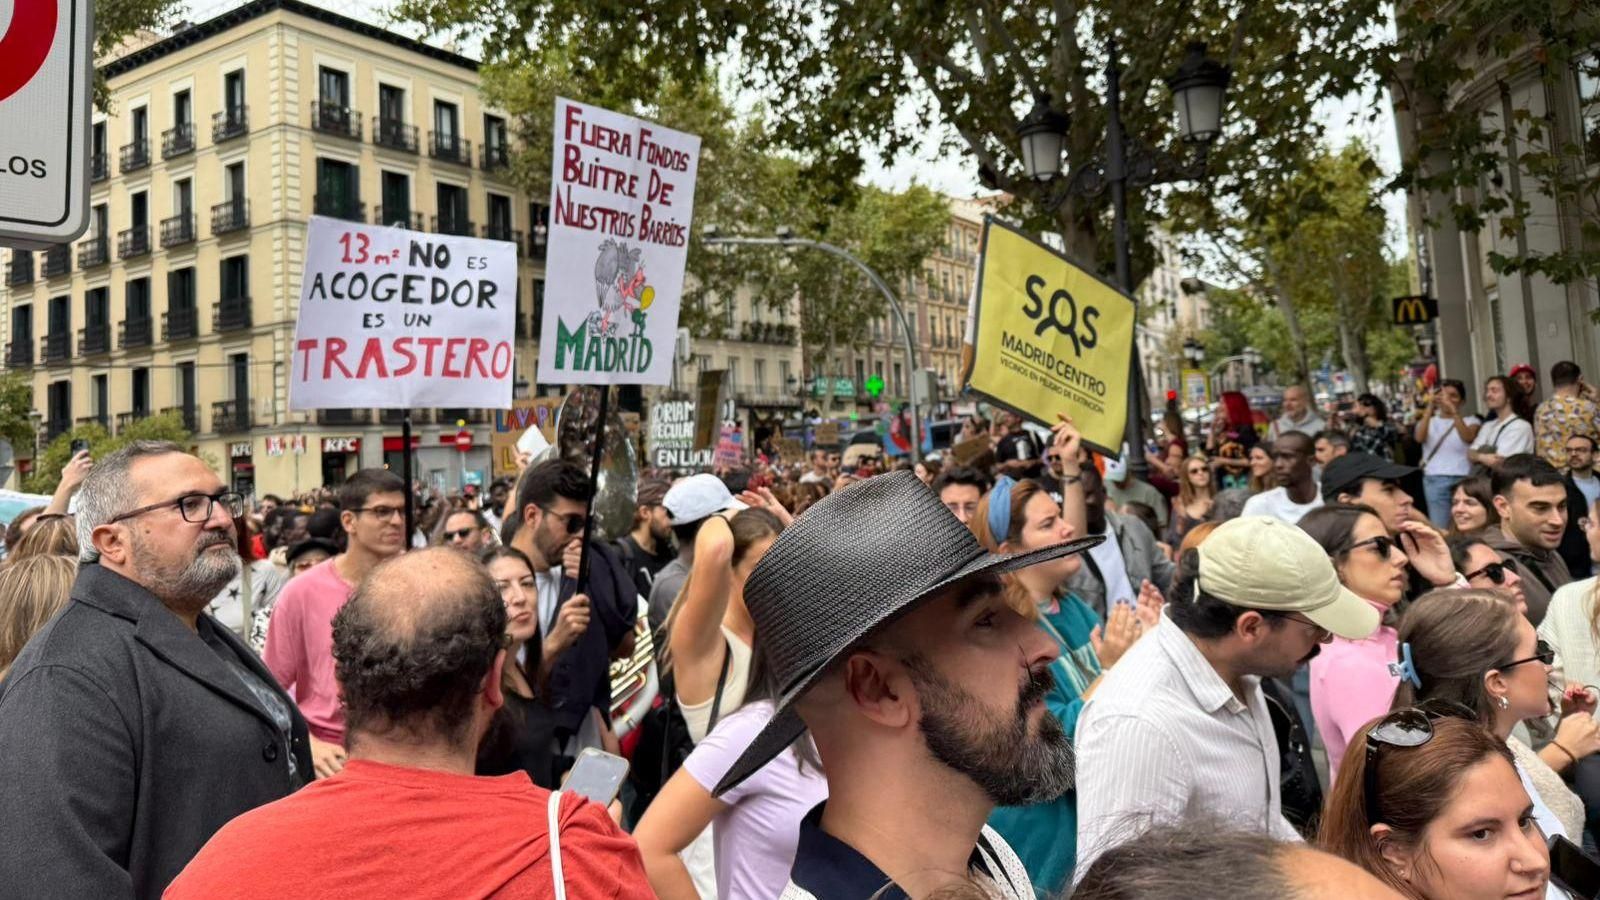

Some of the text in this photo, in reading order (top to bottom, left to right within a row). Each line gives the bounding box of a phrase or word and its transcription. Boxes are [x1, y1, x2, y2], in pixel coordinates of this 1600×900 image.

[565, 104, 690, 172] FUERA FONDOS
[0, 155, 47, 179] OS
[647, 168, 674, 206] DE
[555, 184, 635, 238] NUESTROS
[409, 239, 451, 269] NO
[467, 256, 488, 270] ES
[309, 271, 498, 309] ACOGEDOR
[363, 313, 432, 329] ES UN
[1022, 274, 1100, 357] SOS
[297, 337, 512, 382] TRASTERO
[554, 311, 653, 373] MADRID
[1000, 356, 1029, 378] VECINOS
[323, 437, 357, 453] KFC
[657, 449, 678, 466] EN
